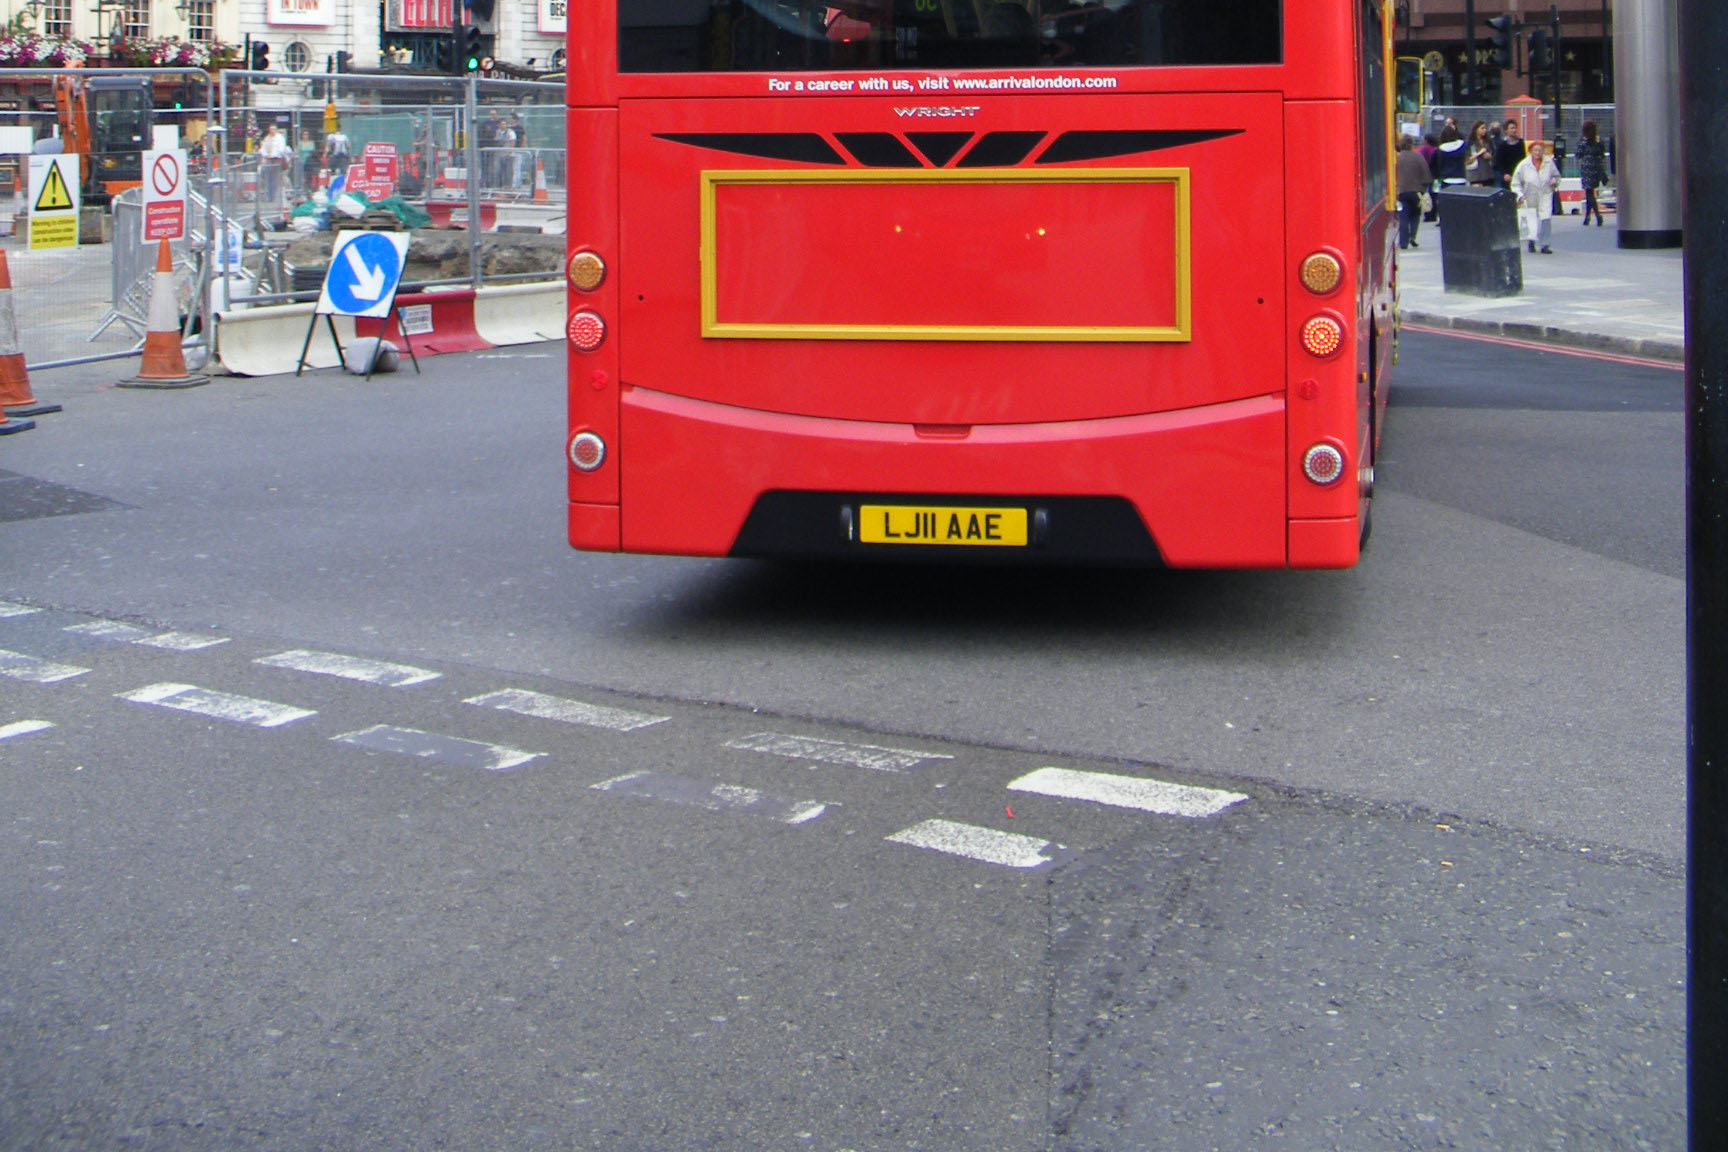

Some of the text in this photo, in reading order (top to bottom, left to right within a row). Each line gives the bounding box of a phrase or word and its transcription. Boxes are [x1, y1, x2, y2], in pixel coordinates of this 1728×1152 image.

[769, 75, 1117, 92] For a career with us, visit www.arrivalondon.com
[893, 106, 981, 117] WRIGHT
[884, 511, 1002, 540] LJ11 AAE
